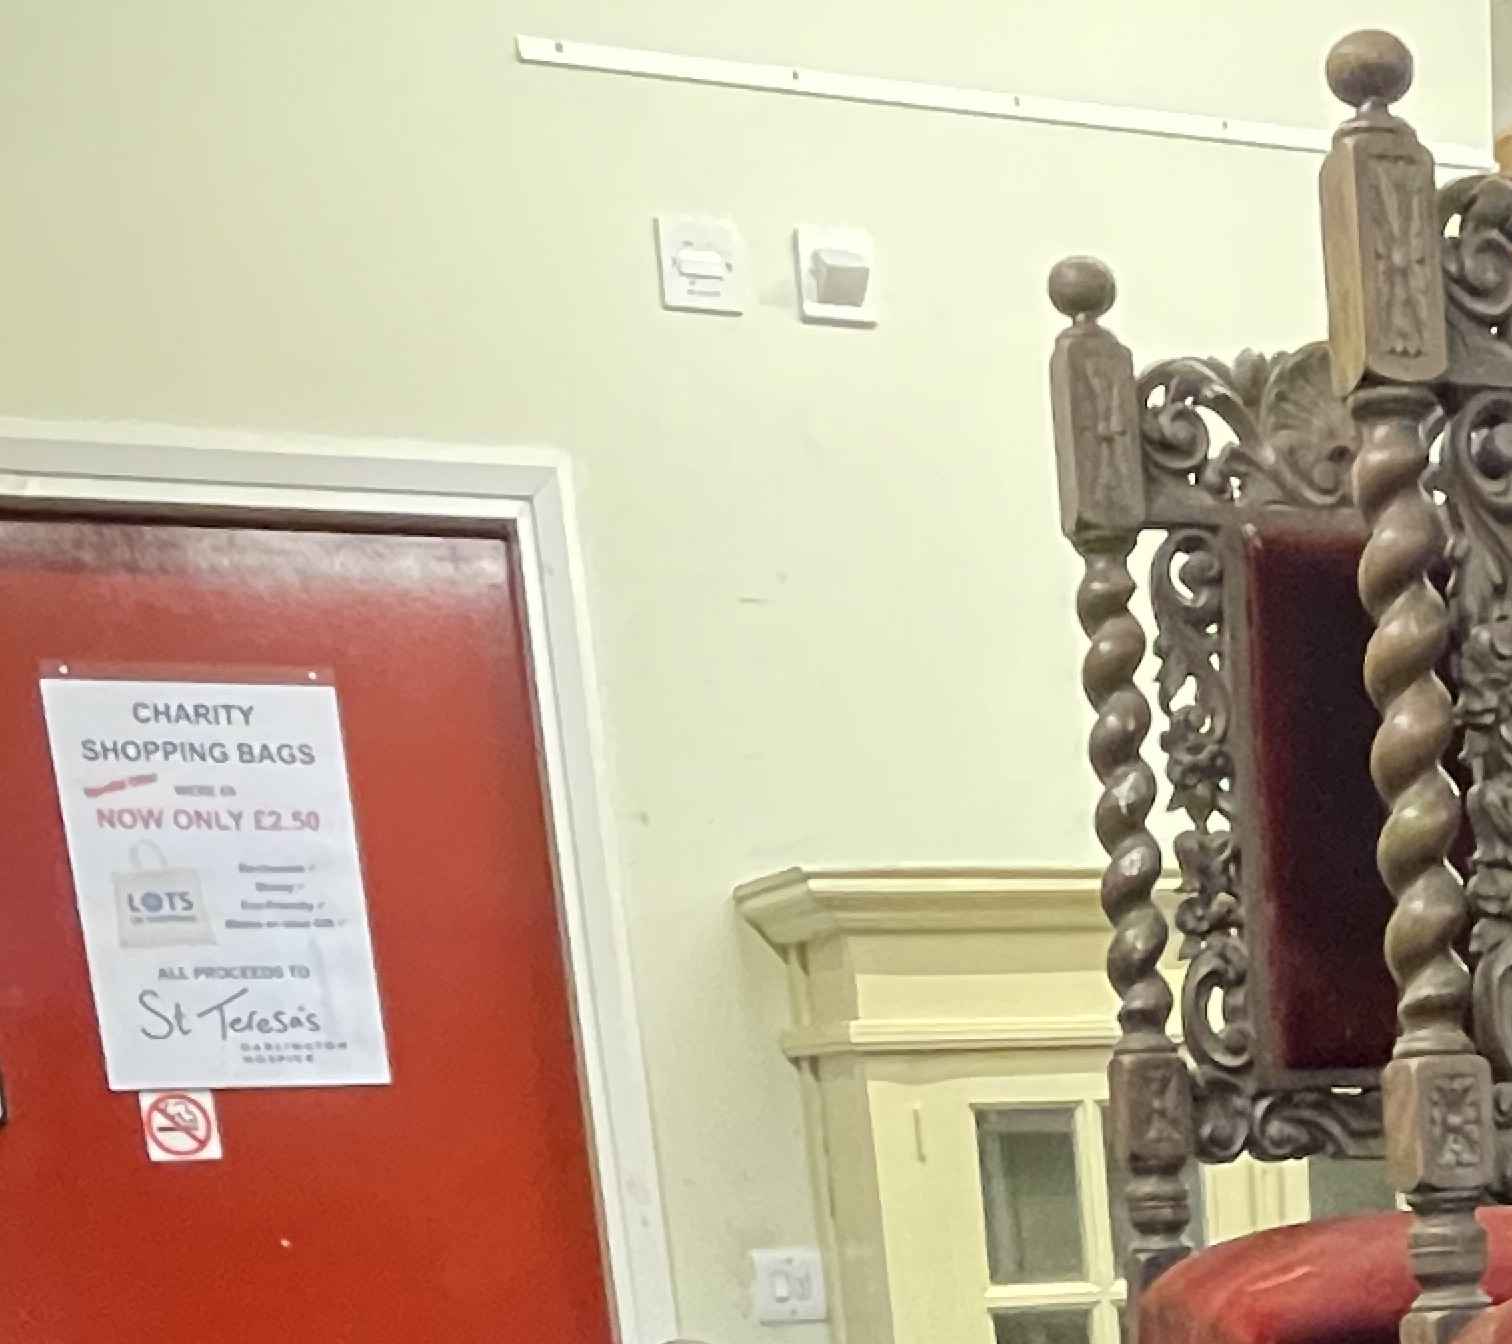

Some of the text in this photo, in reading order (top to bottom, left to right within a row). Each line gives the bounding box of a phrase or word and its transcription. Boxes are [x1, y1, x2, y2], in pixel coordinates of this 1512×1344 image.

[132, 702, 254, 726] CHARITY
[81, 738, 316, 765] SHOPPING BAGS
[96, 806, 320, 831] NOW ONLY £2.50
[127, 891, 194, 913] LOTS
[157, 964, 311, 980] ALL PROCEEDS TO
[138, 986, 321, 1041] St Teresa's
